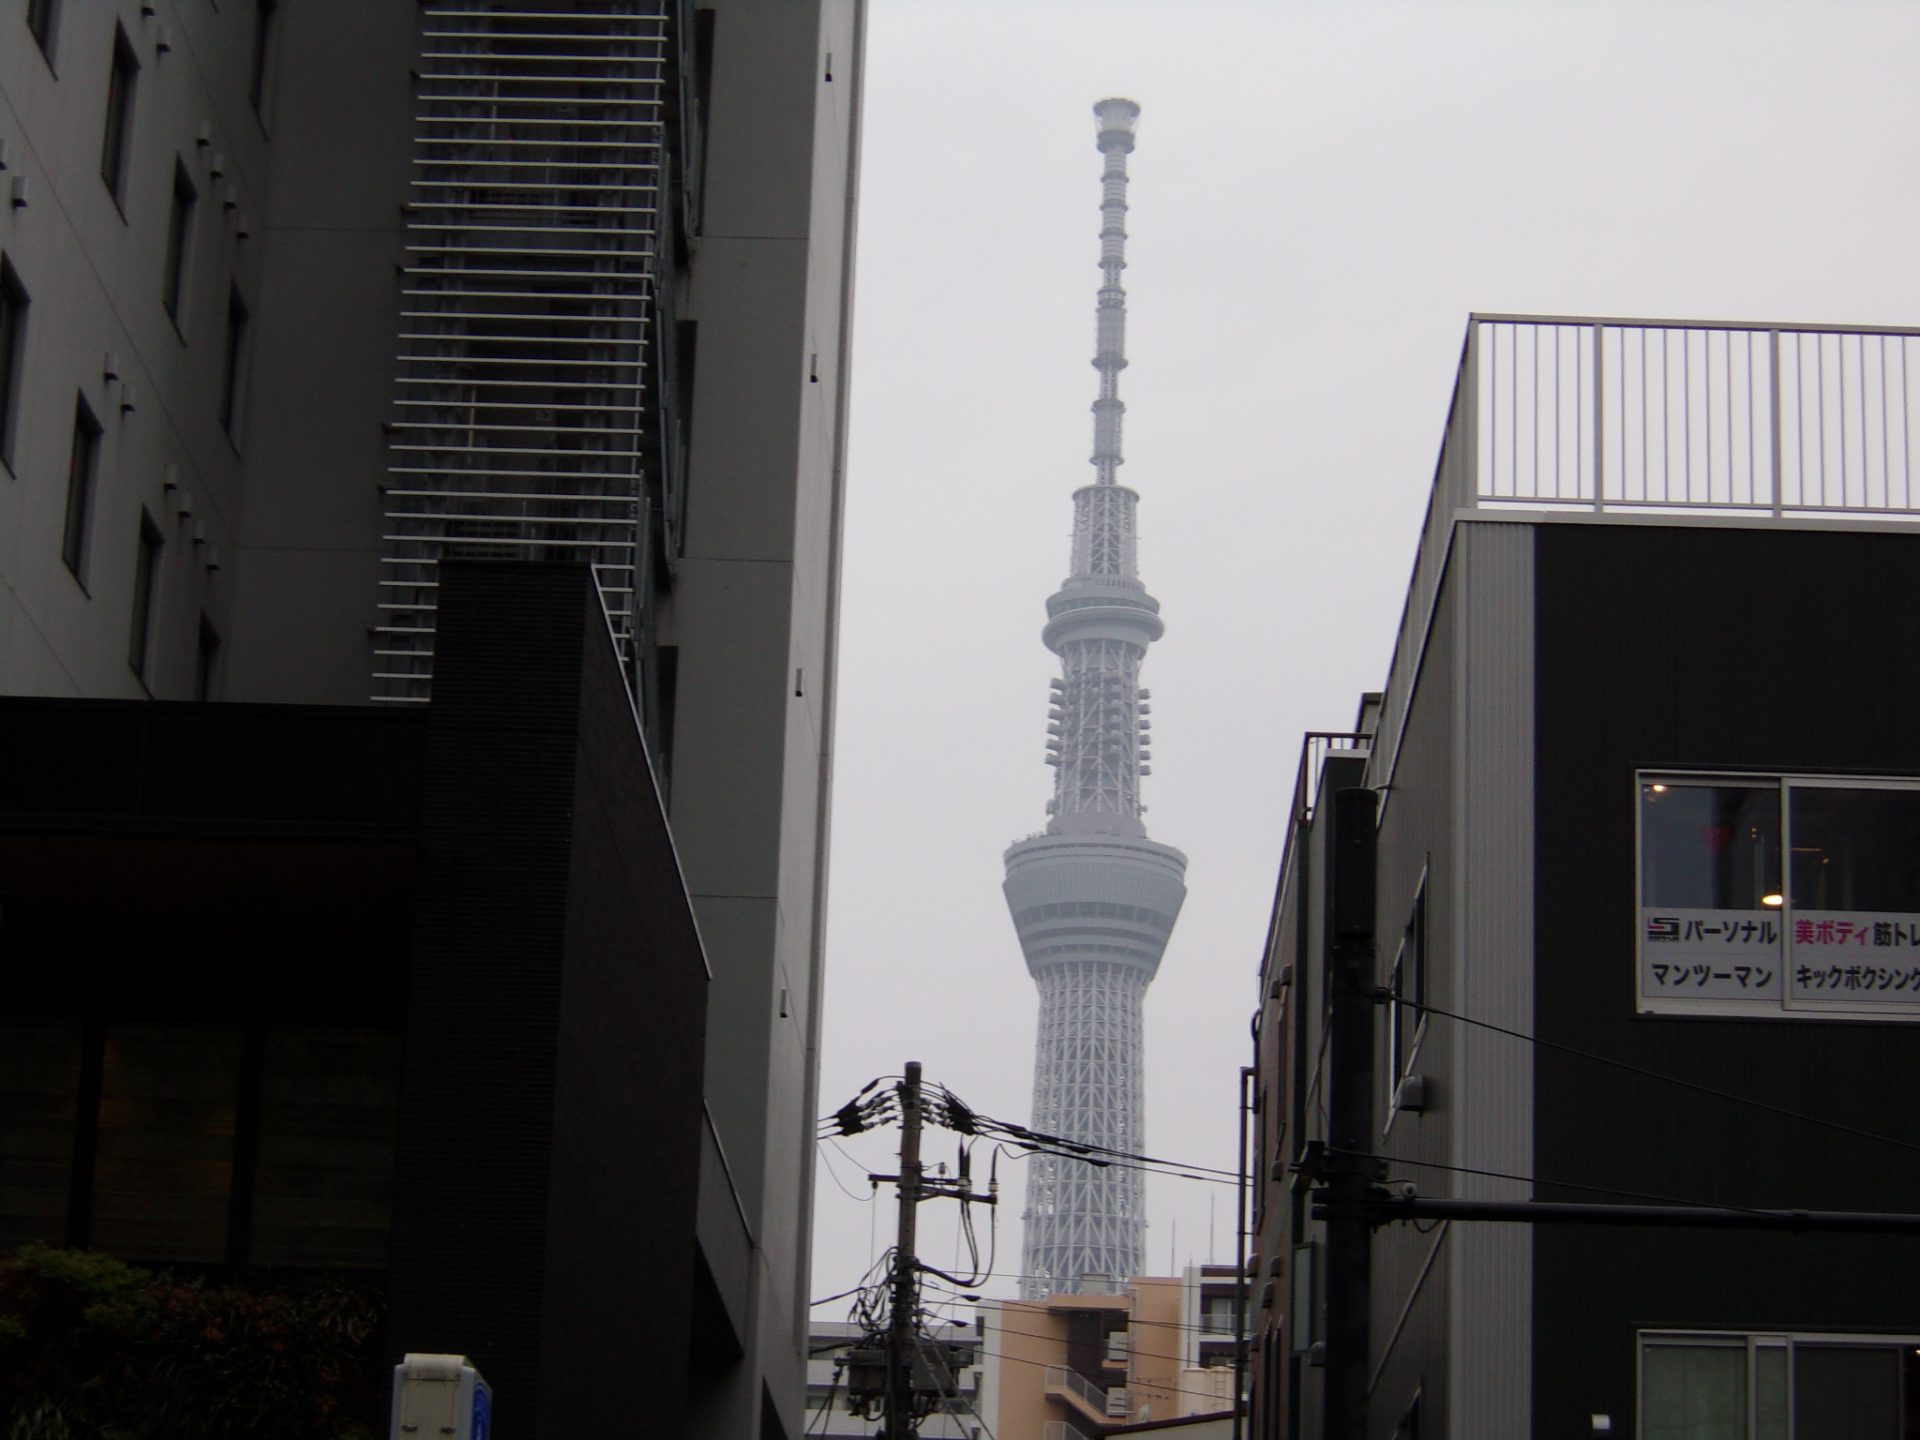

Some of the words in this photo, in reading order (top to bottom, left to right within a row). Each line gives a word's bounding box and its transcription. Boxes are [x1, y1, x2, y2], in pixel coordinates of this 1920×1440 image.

[1685, 920, 1777, 945] パーソナル
[1652, 964, 1772, 988] マンツーマン
